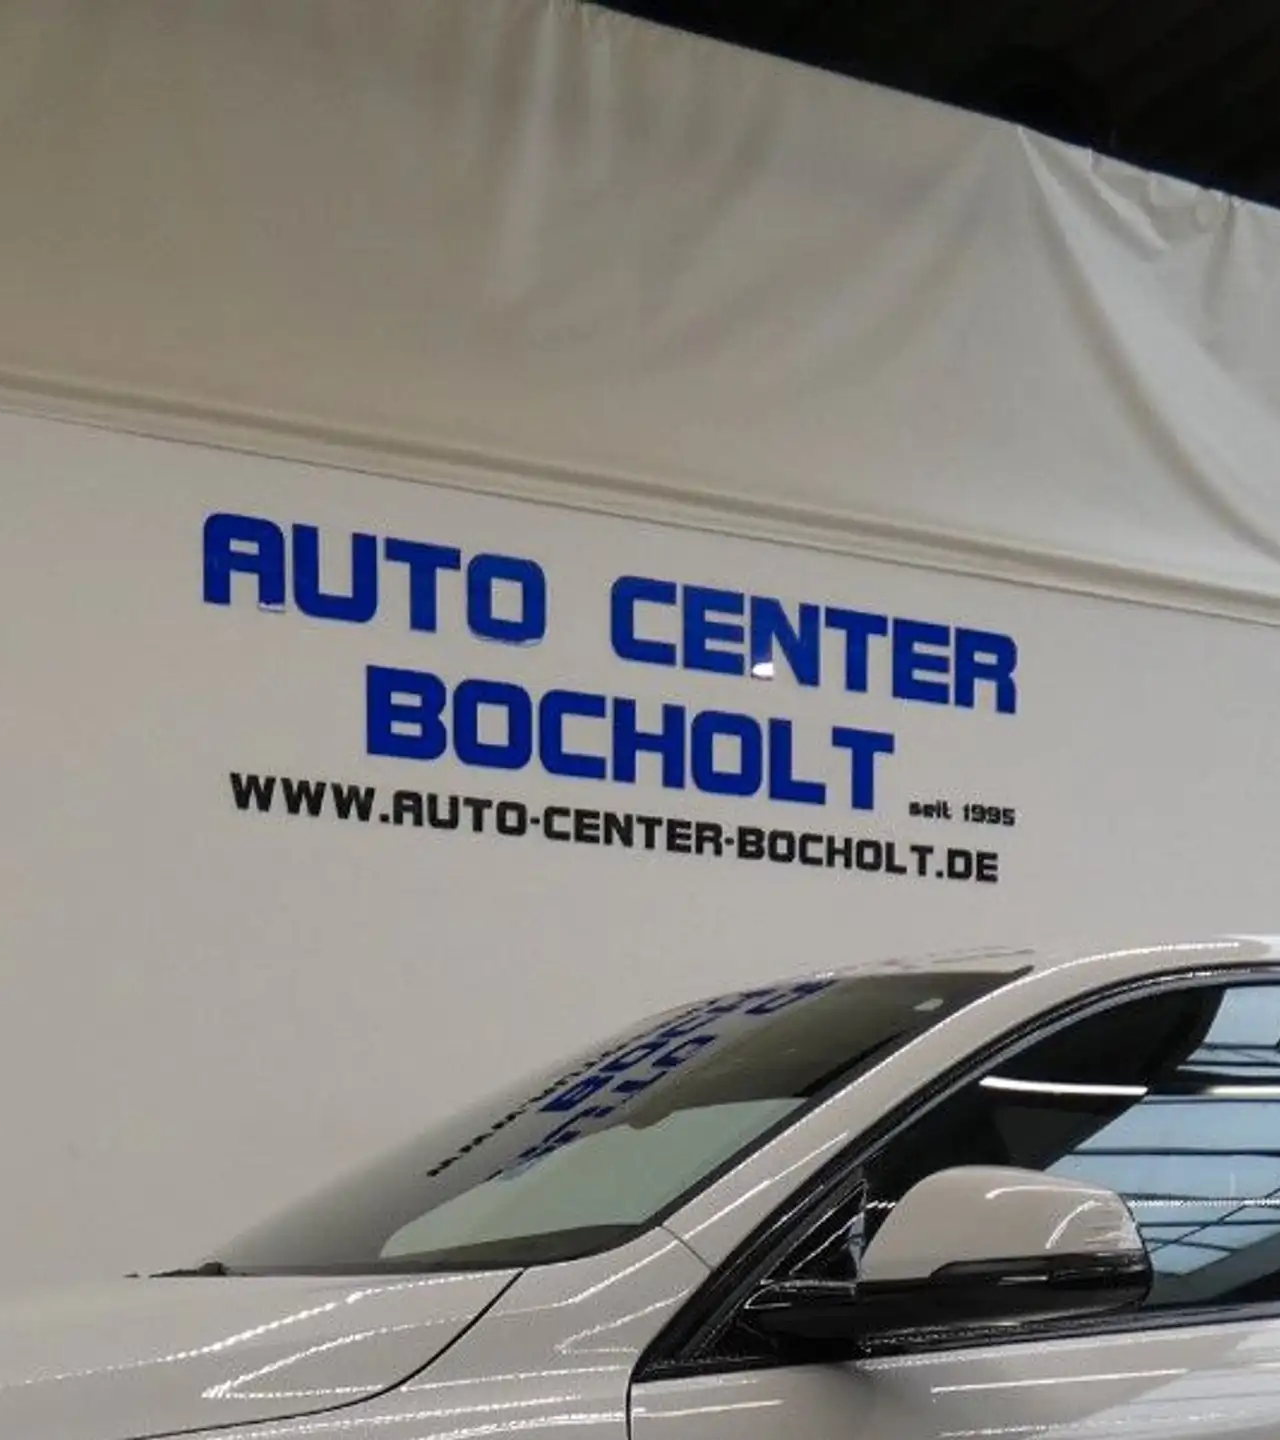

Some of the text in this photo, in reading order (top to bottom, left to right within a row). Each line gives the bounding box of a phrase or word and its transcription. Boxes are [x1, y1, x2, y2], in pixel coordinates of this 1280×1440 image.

[203, 513, 1017, 714] AUTO CENTER
[365, 665, 895, 810] BOCHOLT
[229, 771, 999, 883] WWW.AUTO-CENTER-BOCHOLT.DE
[908, 800, 1016, 827] seit 1995
